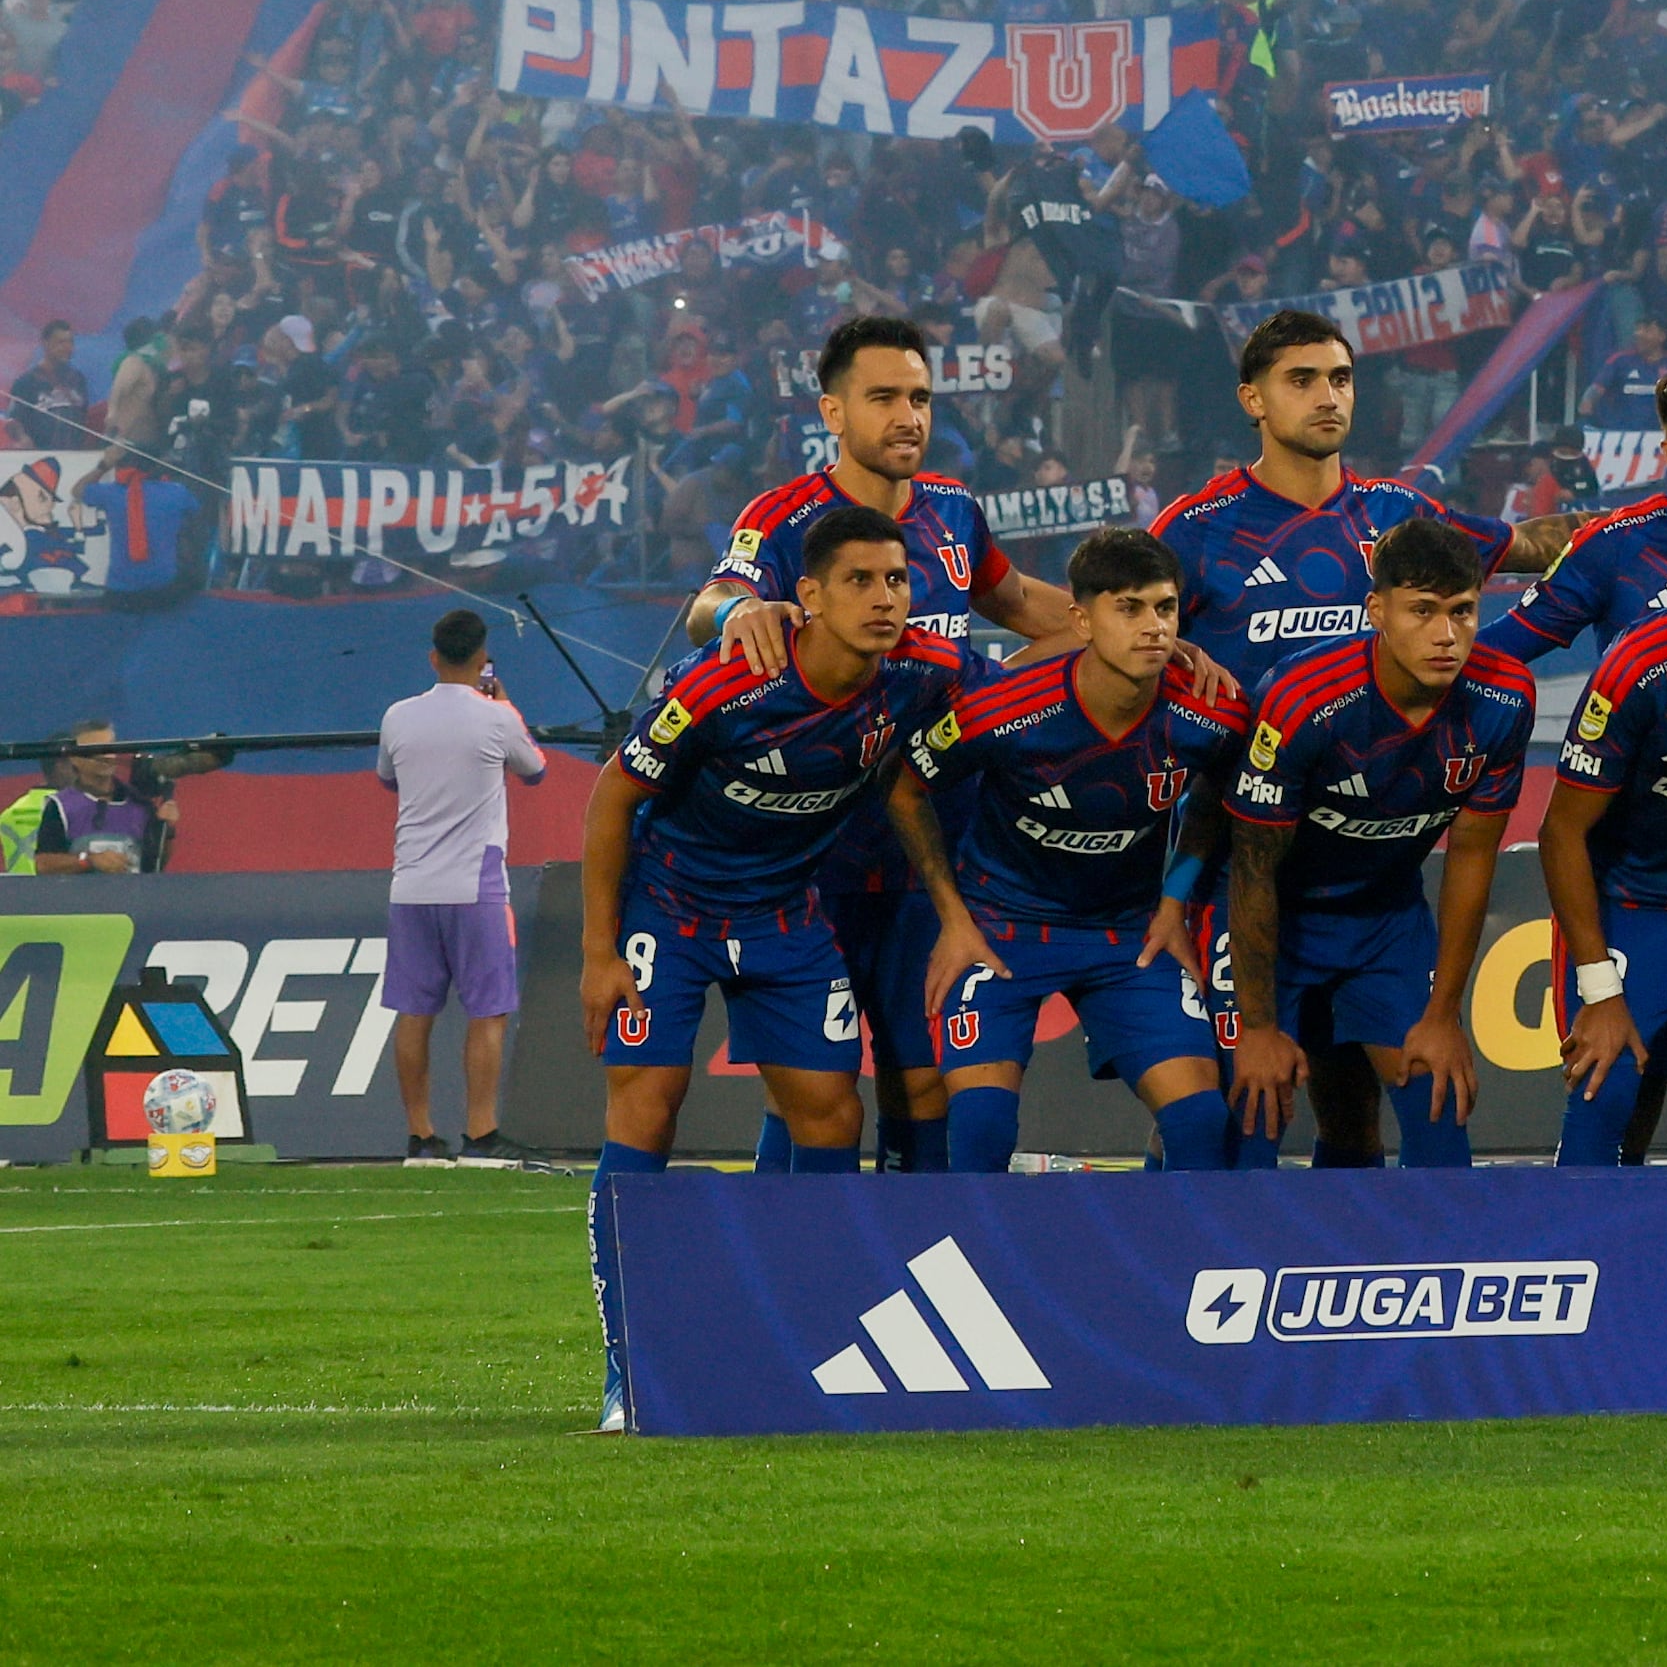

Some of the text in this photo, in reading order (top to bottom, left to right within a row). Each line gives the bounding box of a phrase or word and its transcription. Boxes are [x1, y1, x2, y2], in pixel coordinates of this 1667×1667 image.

[231, 465, 464, 556] MAIPU
[936, 543, 973, 592] U
[719, 676, 789, 716] MACHBANK
[1311, 685, 1369, 727] MACHBANK
[993, 701, 1066, 738] MACHBANK
[1167, 701, 1231, 740] MACHBANK
[1147, 767, 1189, 812] U
[1443, 753, 1487, 794] U
[947, 1010, 981, 1051] U
[1281, 1272, 1585, 1331] JUGABET
